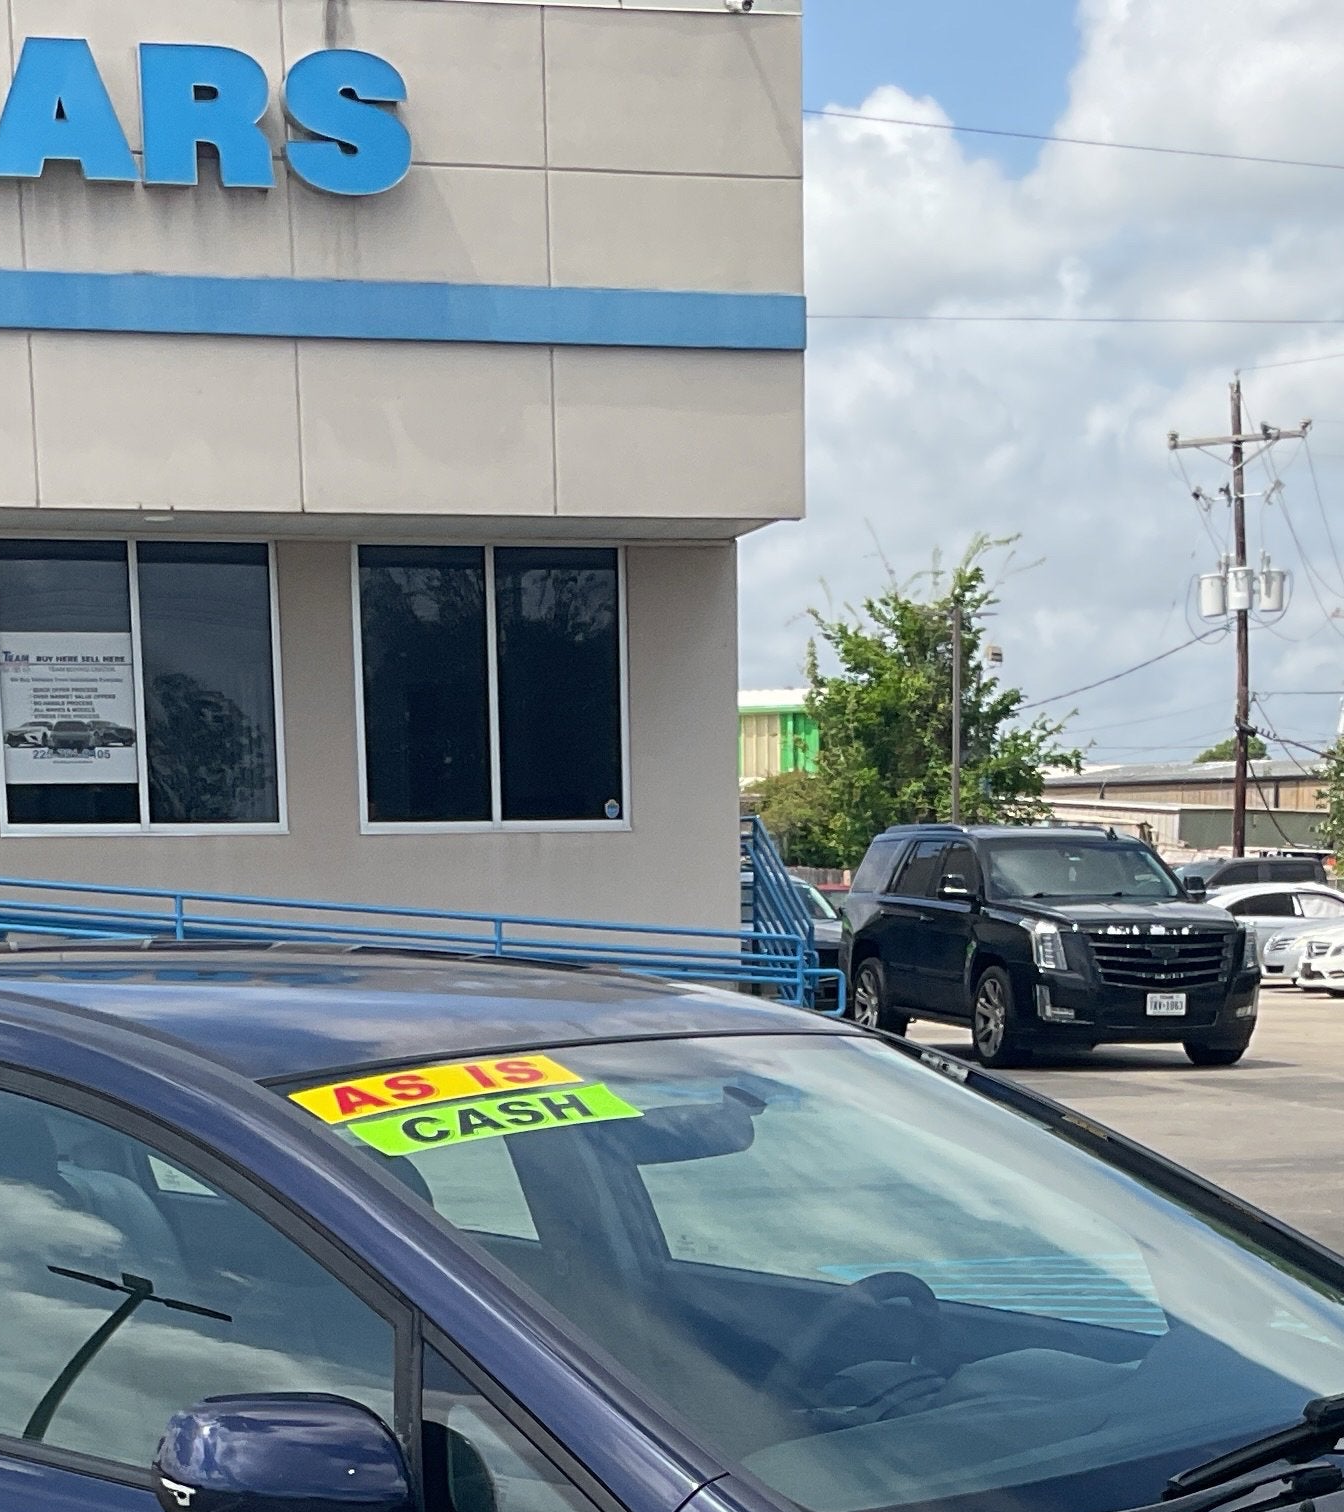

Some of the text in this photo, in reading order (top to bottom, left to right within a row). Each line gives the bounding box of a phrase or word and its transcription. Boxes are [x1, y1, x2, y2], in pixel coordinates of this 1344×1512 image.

[333, 1060, 546, 1116] AS IS
[401, 1093, 594, 1144] CASH
